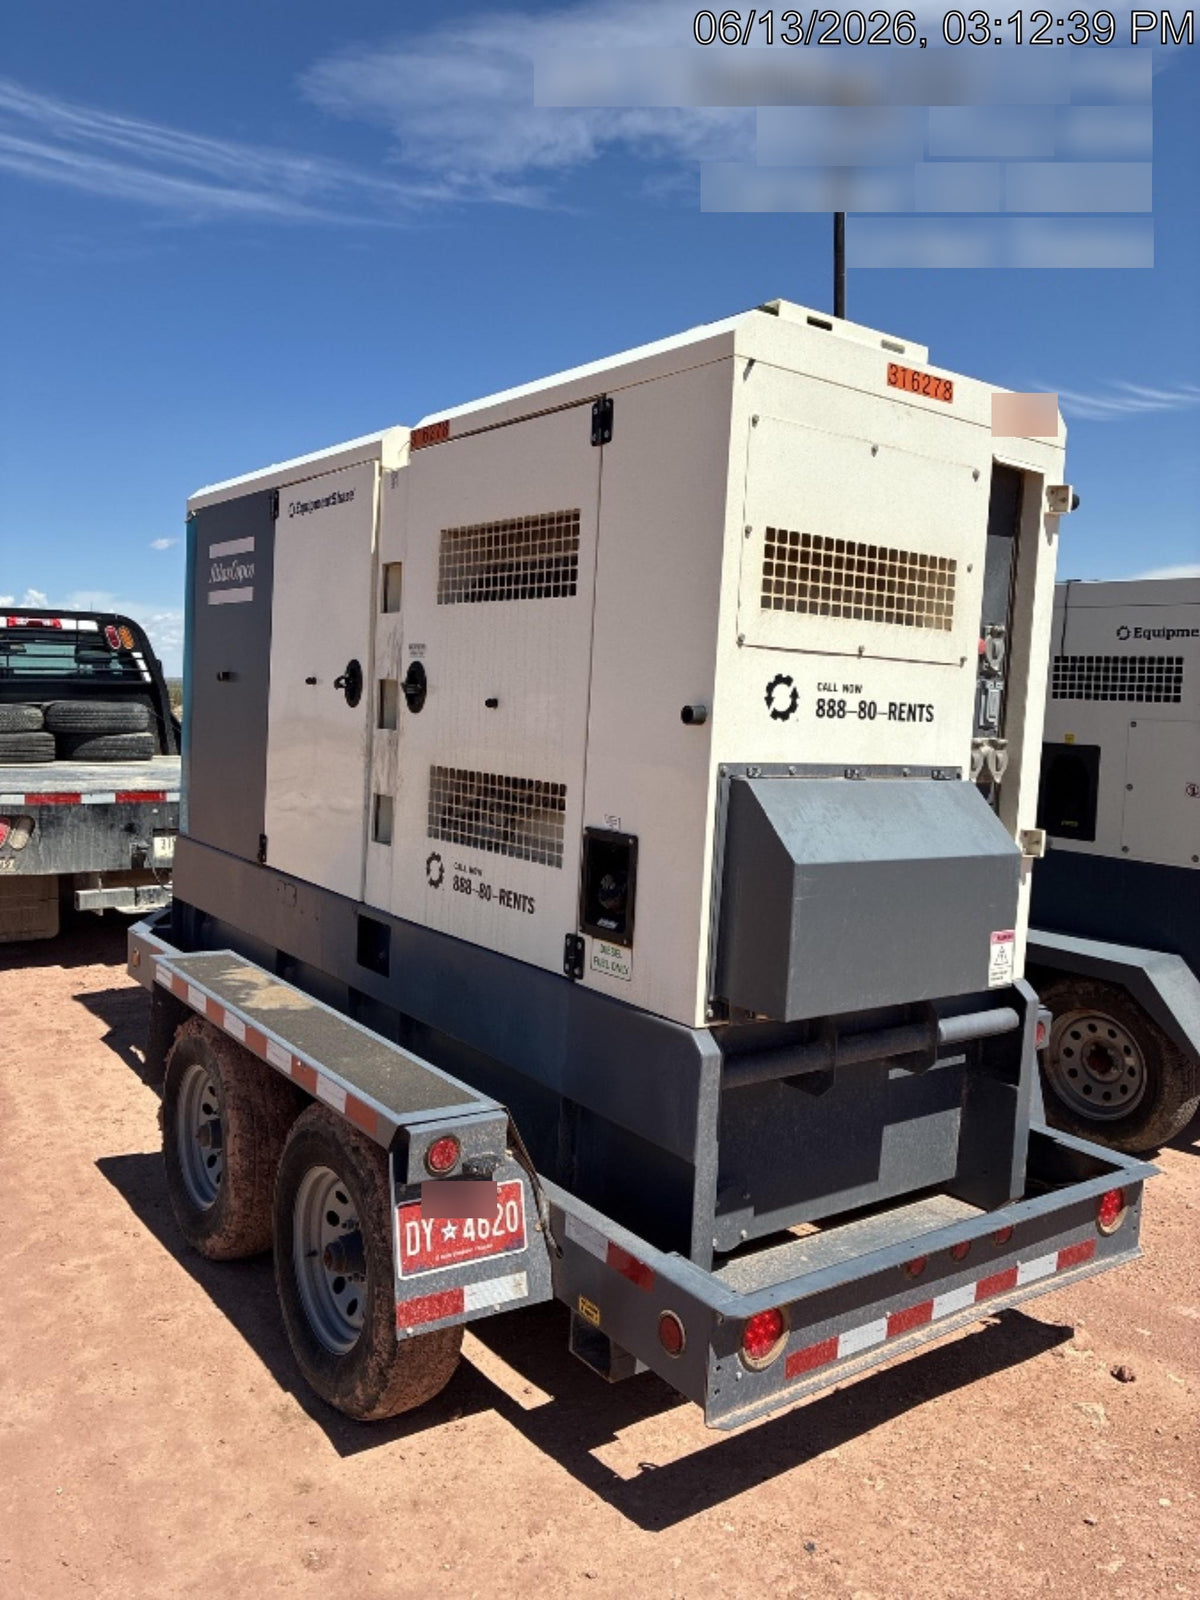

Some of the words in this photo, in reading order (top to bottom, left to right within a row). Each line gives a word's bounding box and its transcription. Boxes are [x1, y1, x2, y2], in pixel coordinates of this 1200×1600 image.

[888, 362, 953, 402] 316278
[817, 682, 838, 692] CALL
[815, 698, 934, 722] 888-80-RENTS
[453, 875, 535, 914] 888-80-RENTS
[405, 1218, 434, 1256] DY
